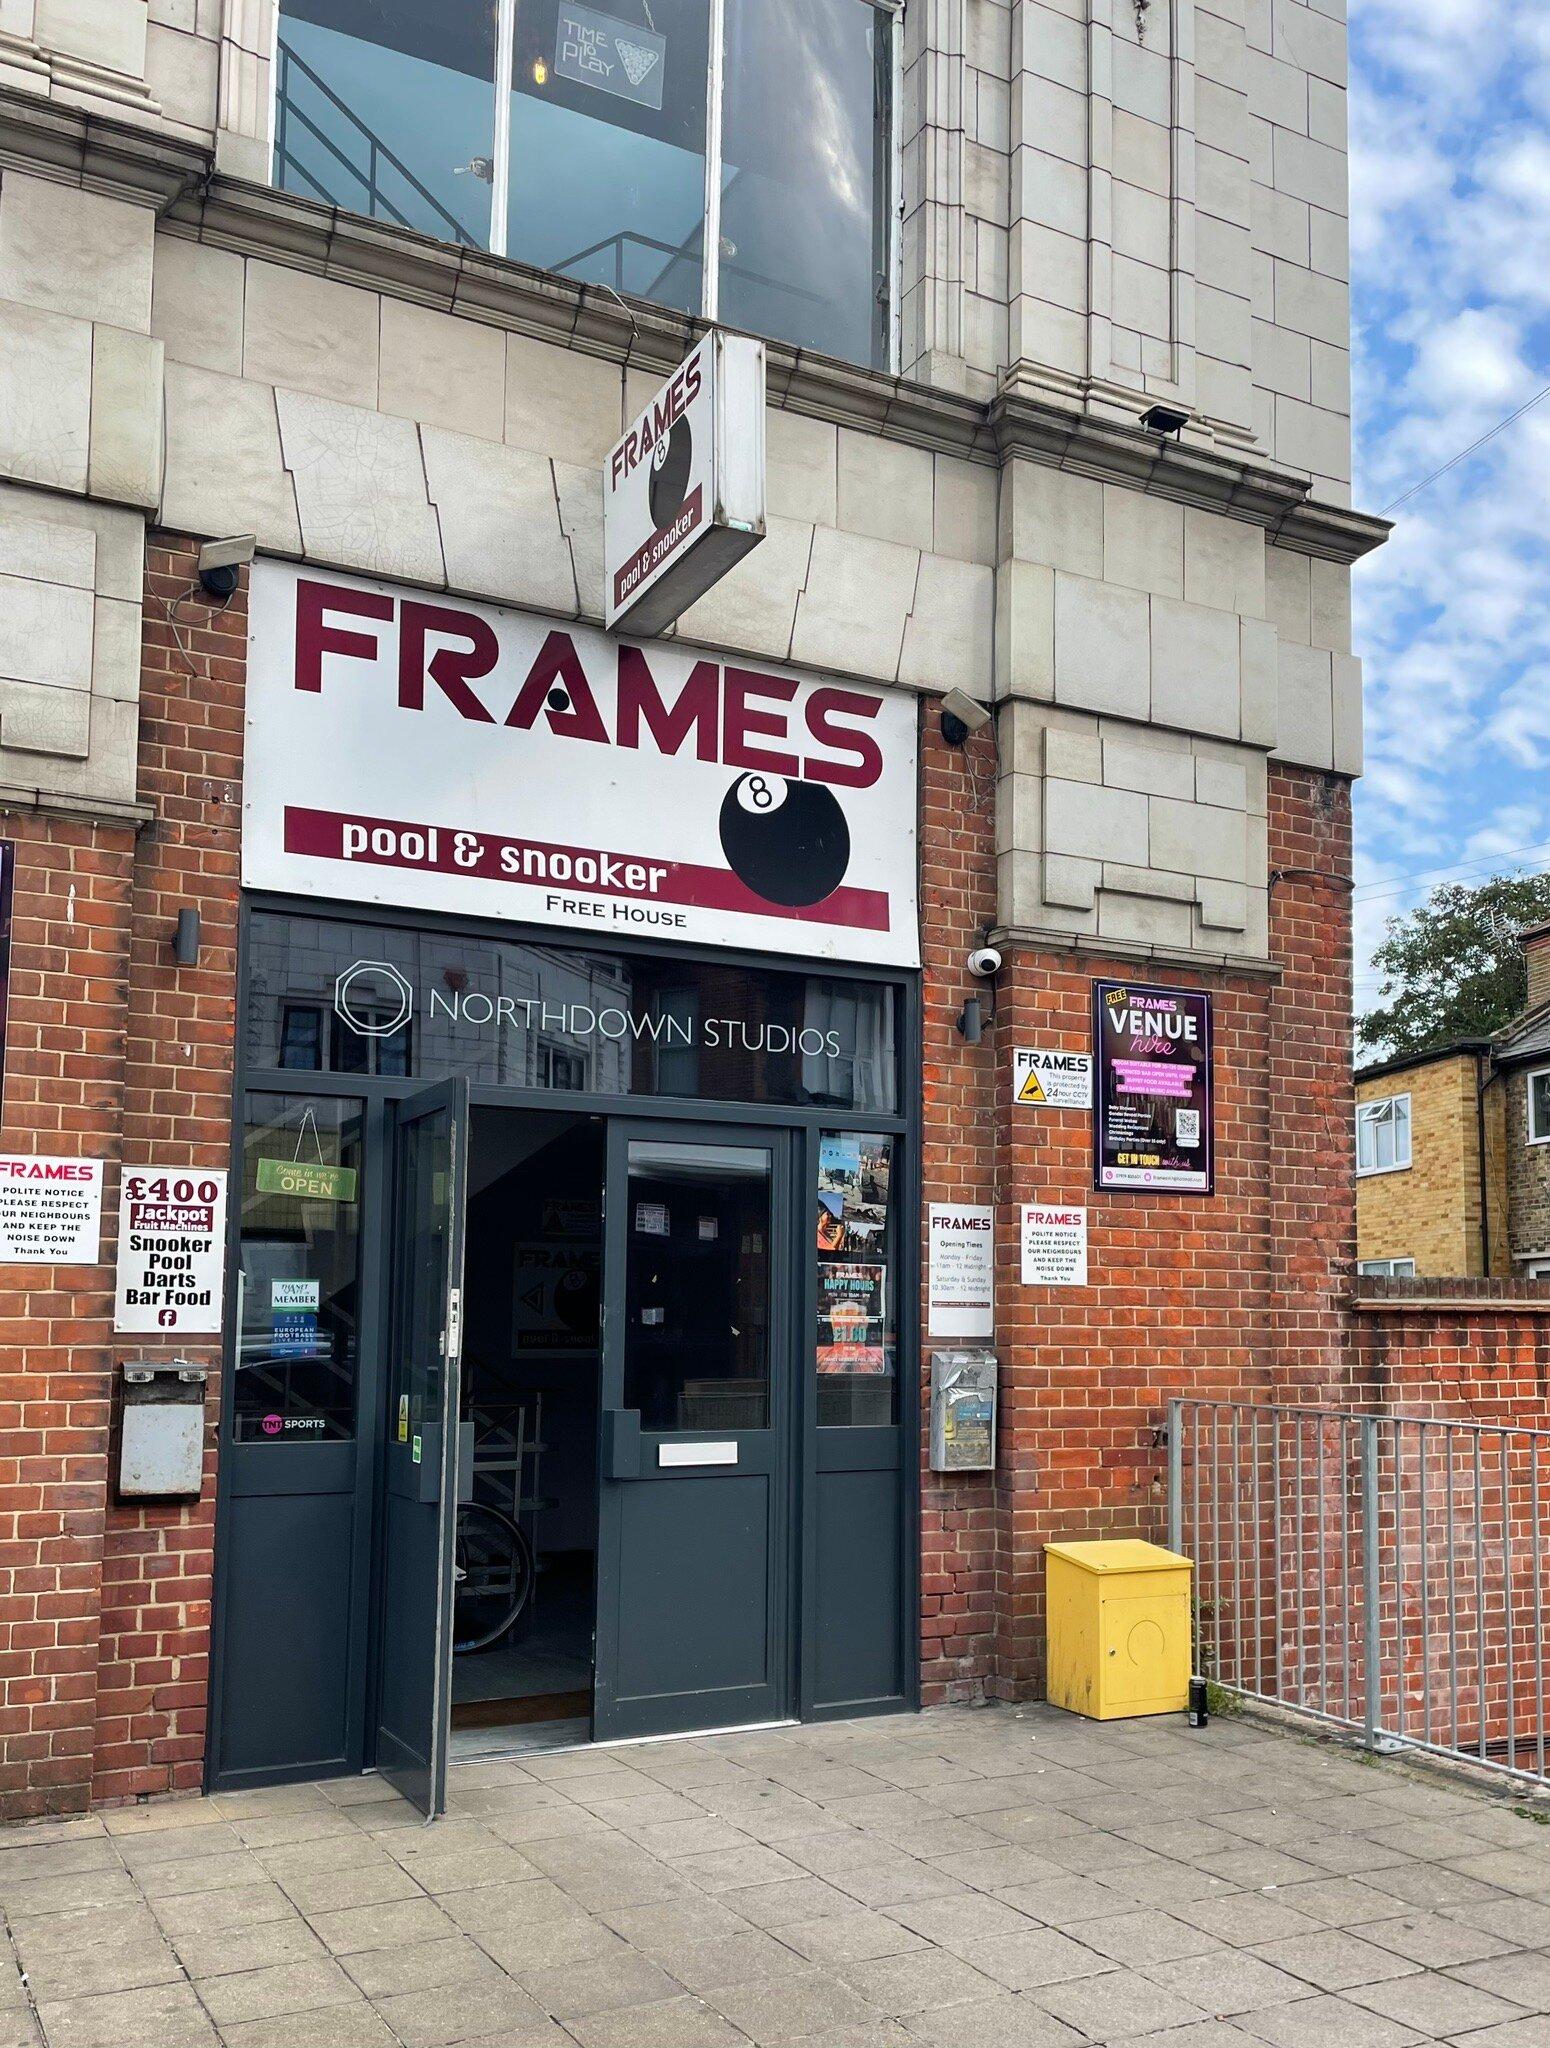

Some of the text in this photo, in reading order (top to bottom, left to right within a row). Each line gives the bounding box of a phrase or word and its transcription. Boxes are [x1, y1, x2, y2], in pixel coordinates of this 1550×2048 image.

[563, 18, 608, 48] TIME
[612, 351, 702, 493] FRAMES
[620, 507, 694, 600] pool & snooker
[295, 578, 884, 788] FRAMES
[747, 774, 773, 809] 8
[341, 821, 667, 893] pool & snooker
[546, 895, 687, 928] FREE HOUSE
[1106, 990, 1126, 1003] FREE
[1129, 996, 1177, 1012] FRAMES
[430, 988, 841, 1060] NORTHDOWN STUDIOS
[1108, 1008, 1198, 1041] VENUE
[1130, 1026, 1177, 1055] hire
[1018, 1052, 1088, 1072] FRAMES
[1062, 1074, 1086, 1082] property
[1047, 1088, 1058, 1097] 24
[1117, 1153, 1129, 1164] GET
[3, 1187, 84, 1197] POLITE NOTICE
[126, 1177, 218, 1204] £400
[281, 1176, 332, 1195] OPEN
[0, 1210, 90, 1220] UR NEIGHBOURS
[136, 1204, 208, 1223] Jackpot
[1027, 1212, 1081, 1225] FRAMES
[134, 1221, 208, 1232] Fruit Machines
[933, 1217, 990, 1230] FRAMES
[7, 1234, 40, 1242] NOISE
[130, 1235, 212, 1252] Snooker
[940, 1240, 965, 1249] Opening
[149, 1254, 192, 1270] Pool
[143, 1272, 196, 1288] Darts
[824, 1278, 875, 1292] HAPPY HOURS
[126, 1289, 211, 1306] Bar Food
[263, 1420, 326, 1429] TNT SPORTS
